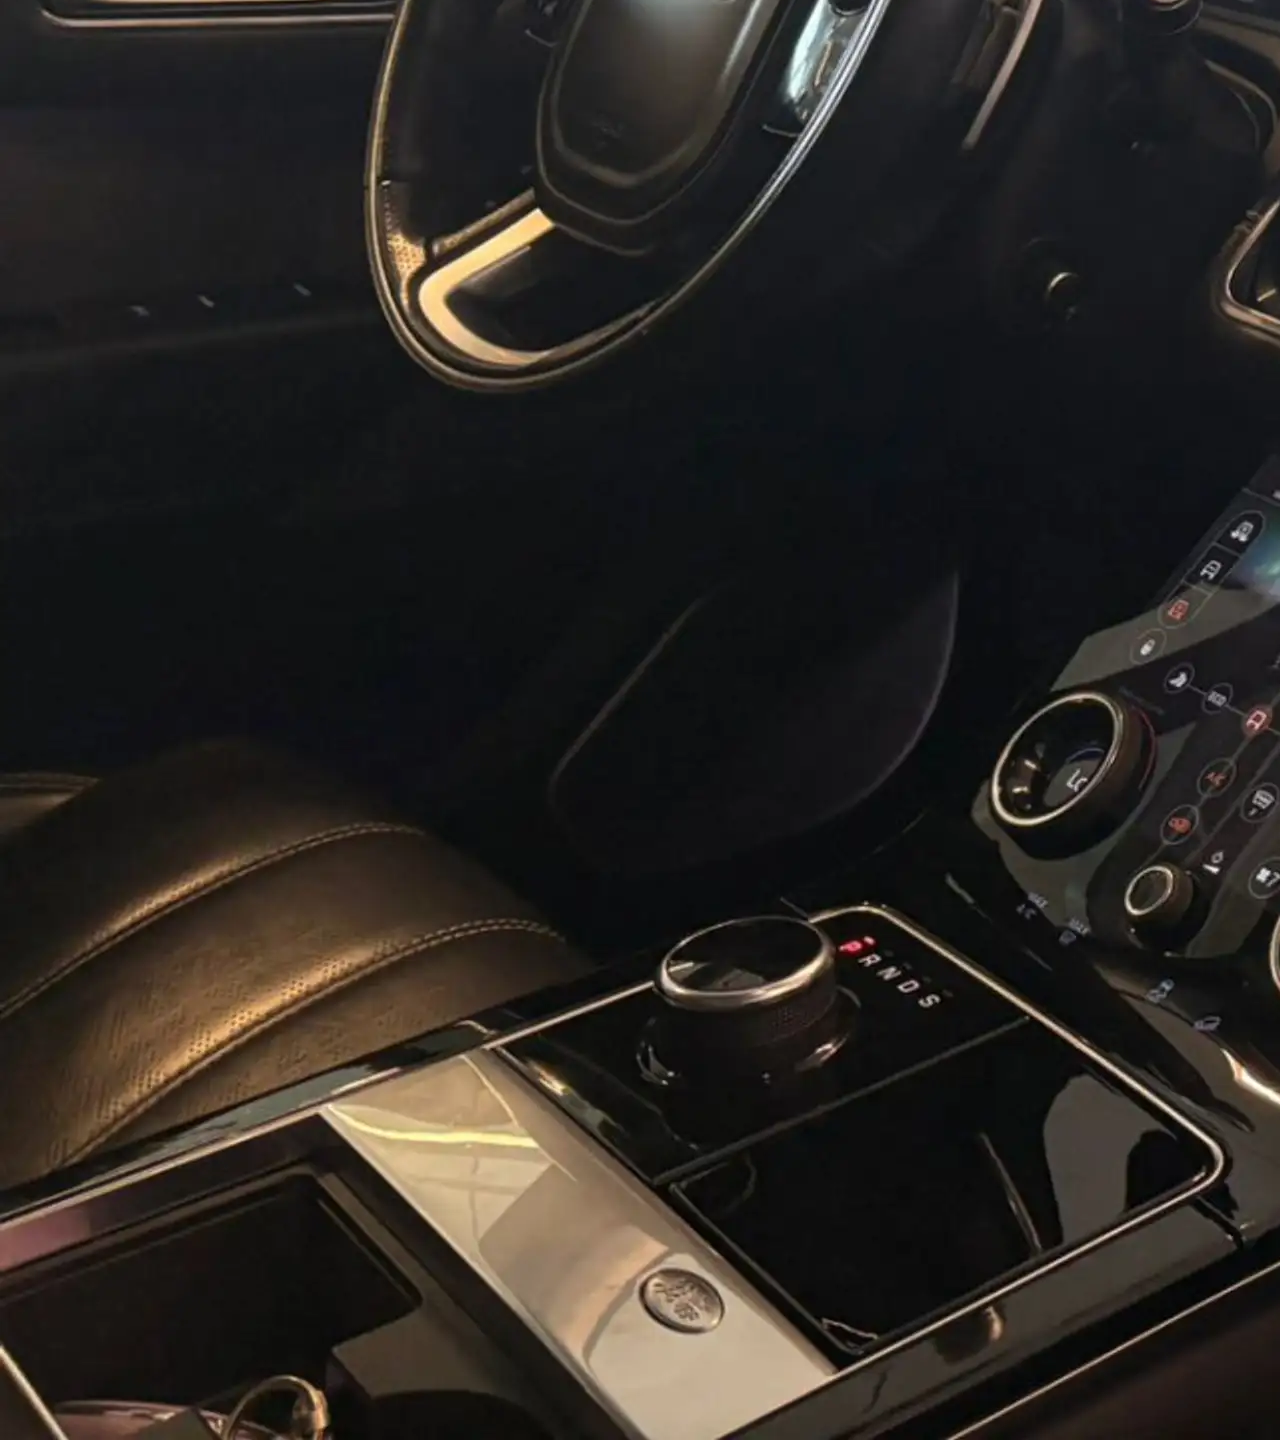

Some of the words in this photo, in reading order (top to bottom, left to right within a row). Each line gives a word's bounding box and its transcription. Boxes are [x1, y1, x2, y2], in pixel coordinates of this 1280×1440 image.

[857, 953, 883, 968] R
[875, 965, 903, 981] N
[896, 979, 921, 994] D
[917, 993, 942, 1008] S
